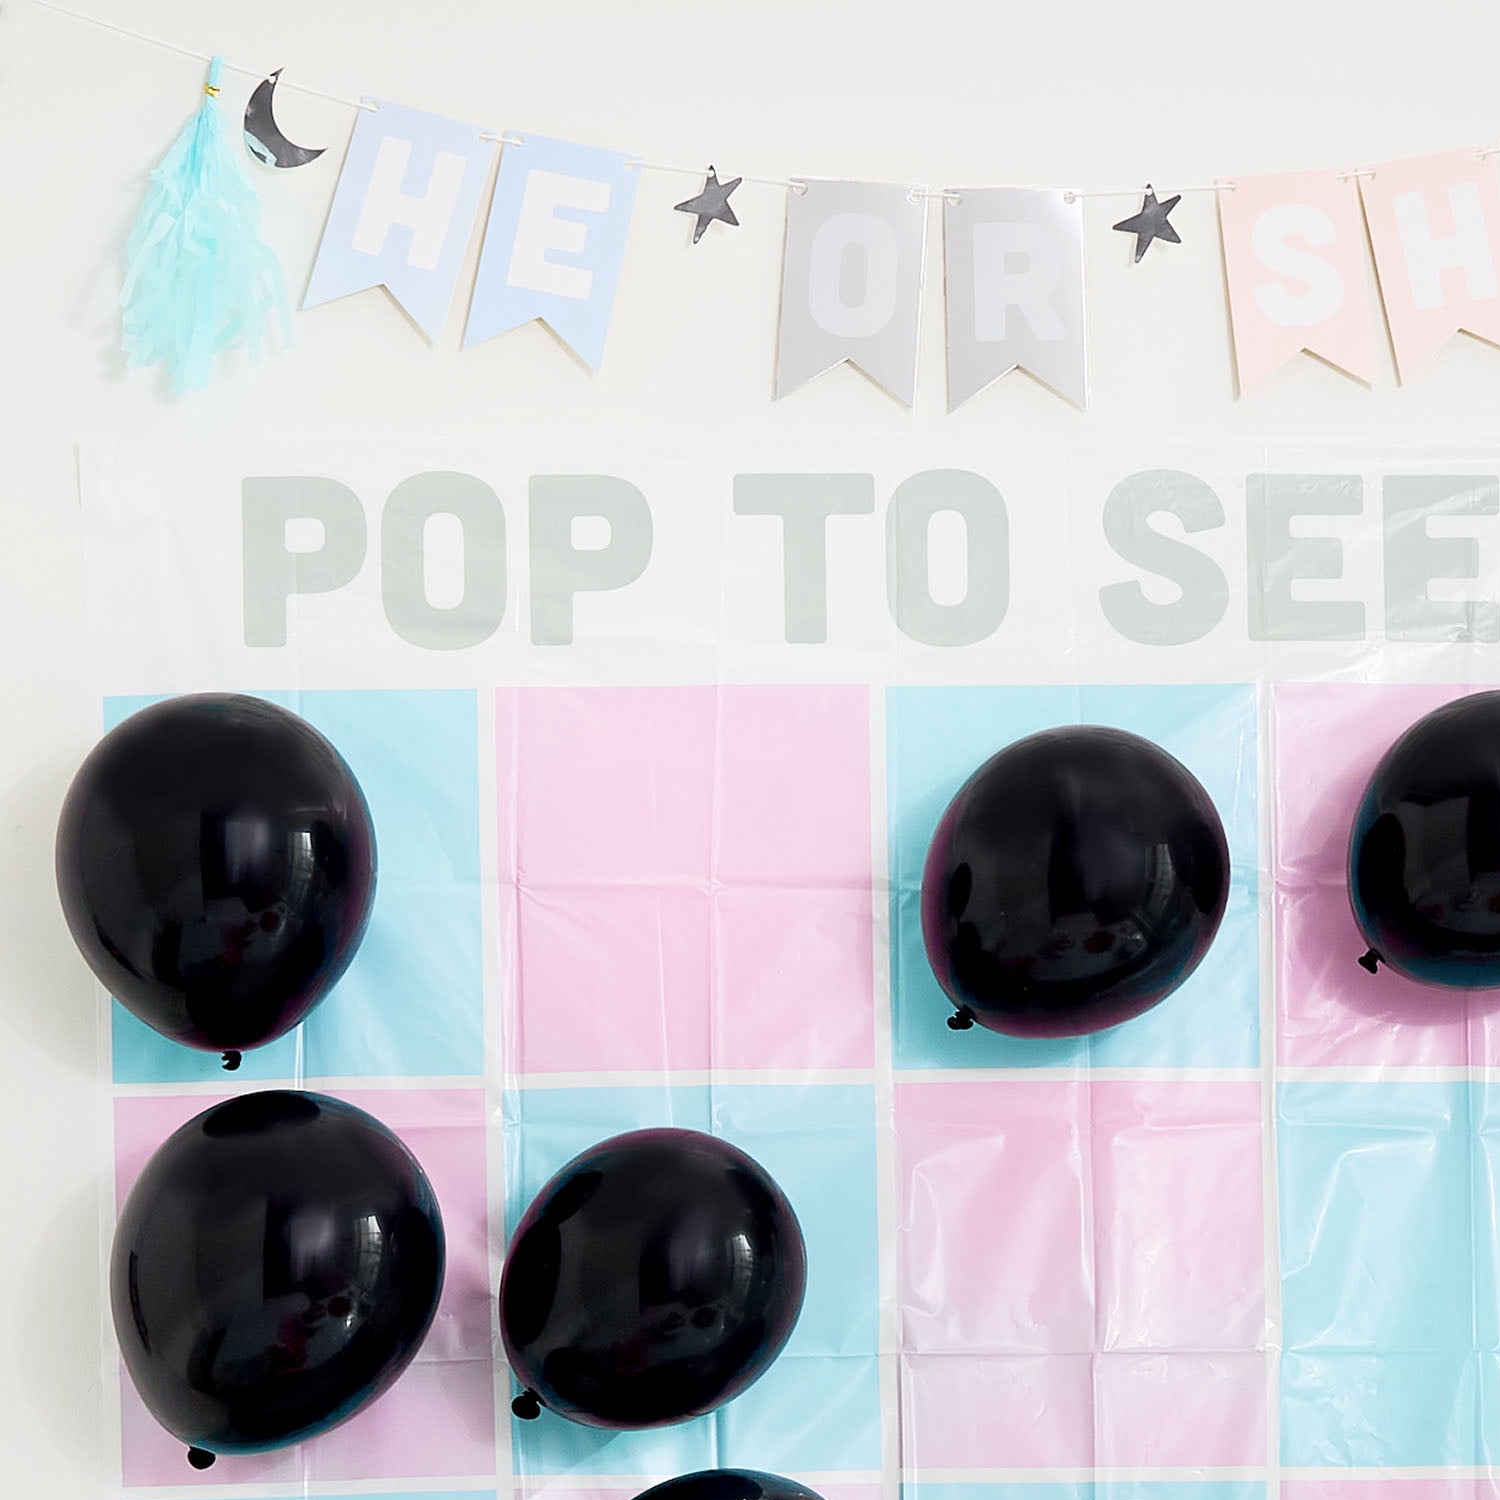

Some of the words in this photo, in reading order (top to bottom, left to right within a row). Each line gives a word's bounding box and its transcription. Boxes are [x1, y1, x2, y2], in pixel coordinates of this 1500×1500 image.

[351, 135, 612, 300] HE
[808, 212, 1068, 343] OR
[241, 470, 654, 651] POP
[732, 468, 1010, 647] TO
